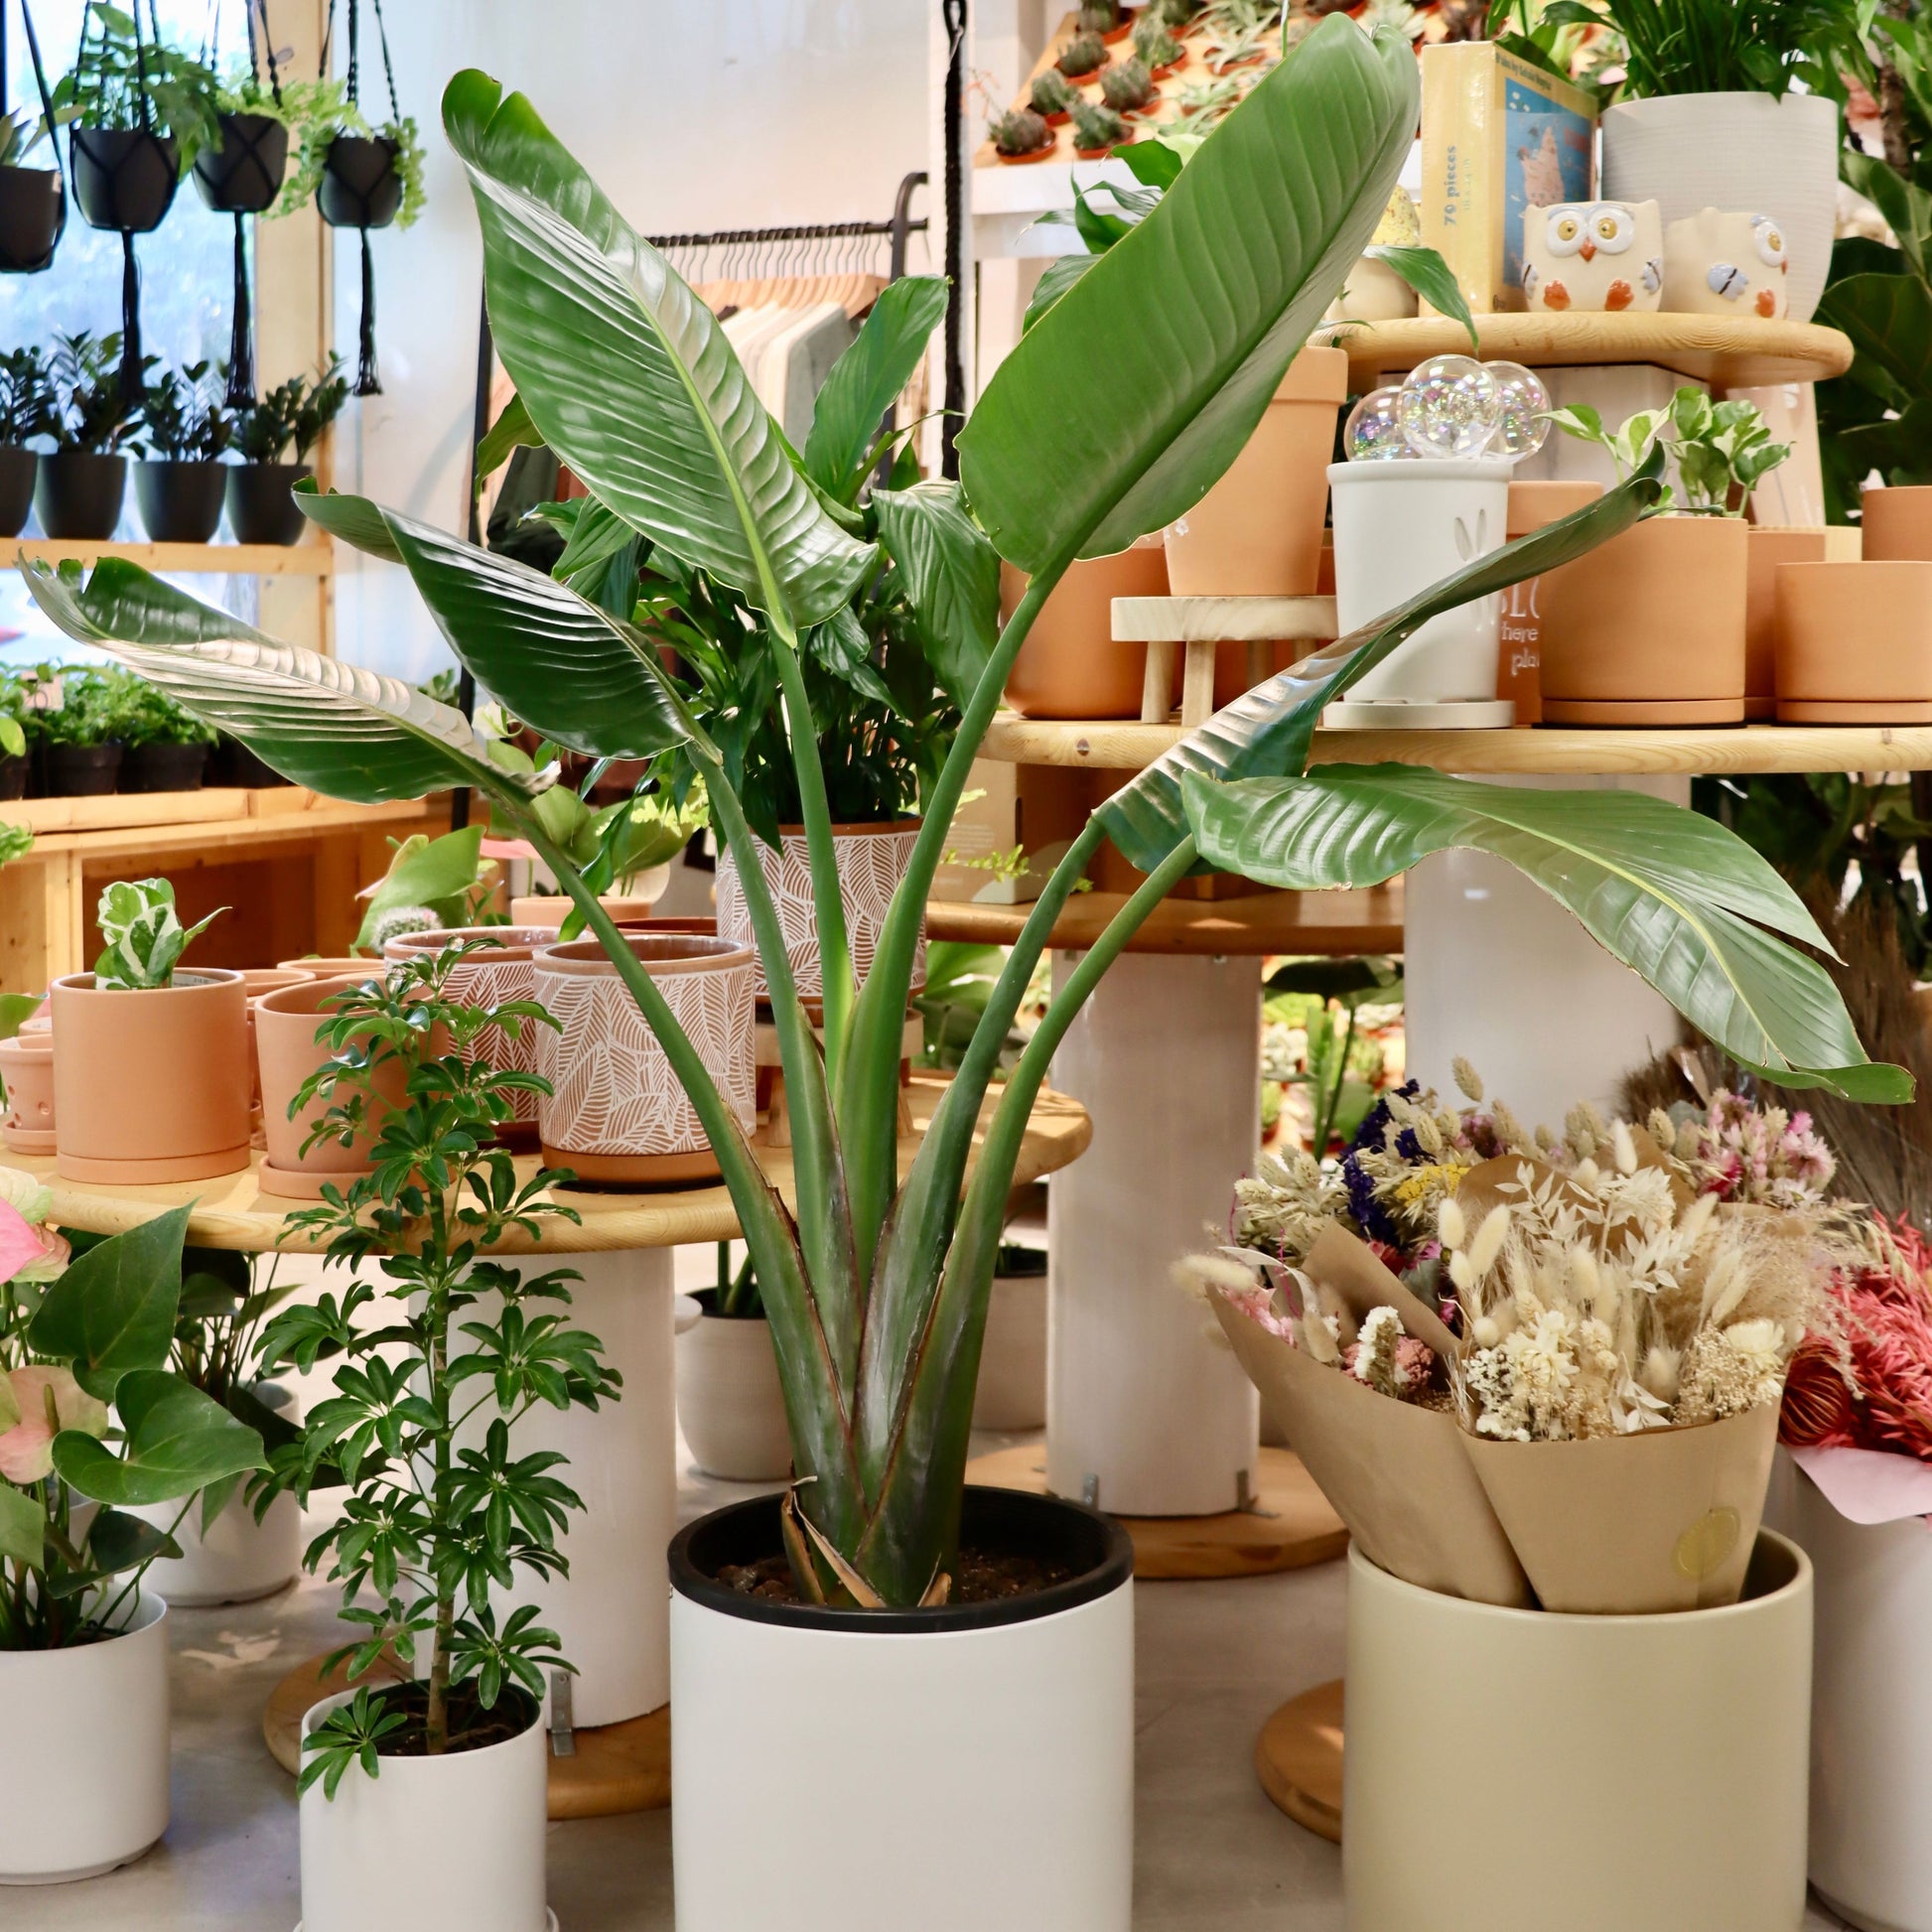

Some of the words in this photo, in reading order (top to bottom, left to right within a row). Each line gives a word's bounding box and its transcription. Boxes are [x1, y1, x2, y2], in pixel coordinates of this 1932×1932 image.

[1444, 145, 1460, 198] pieces
[1444, 204, 1456, 226] 70
[1500, 620, 1538, 643] here
